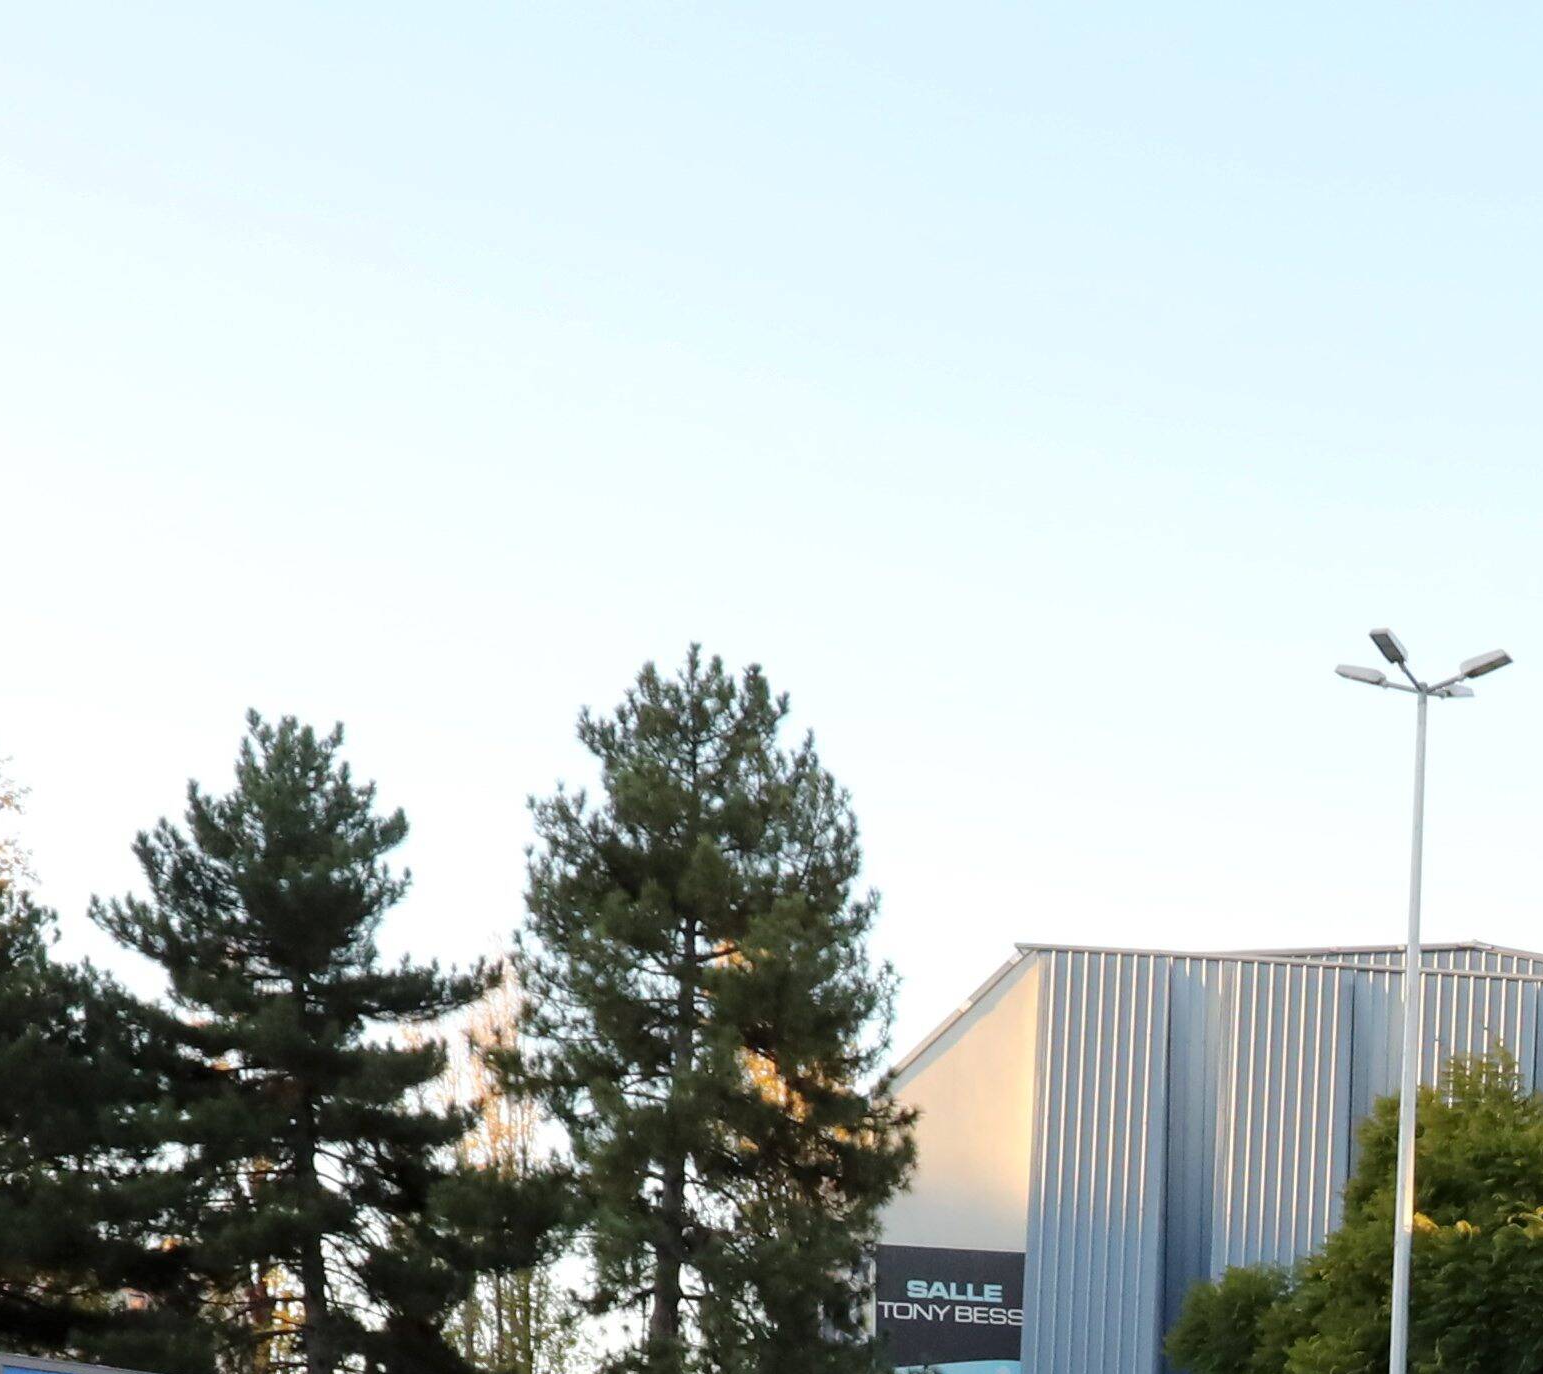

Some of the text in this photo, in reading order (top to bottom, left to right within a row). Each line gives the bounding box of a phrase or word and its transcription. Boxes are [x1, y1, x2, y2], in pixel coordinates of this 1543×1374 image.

[906, 1279, 1003, 1303] SALLE
[877, 1301, 1024, 1327] TONY BESS
